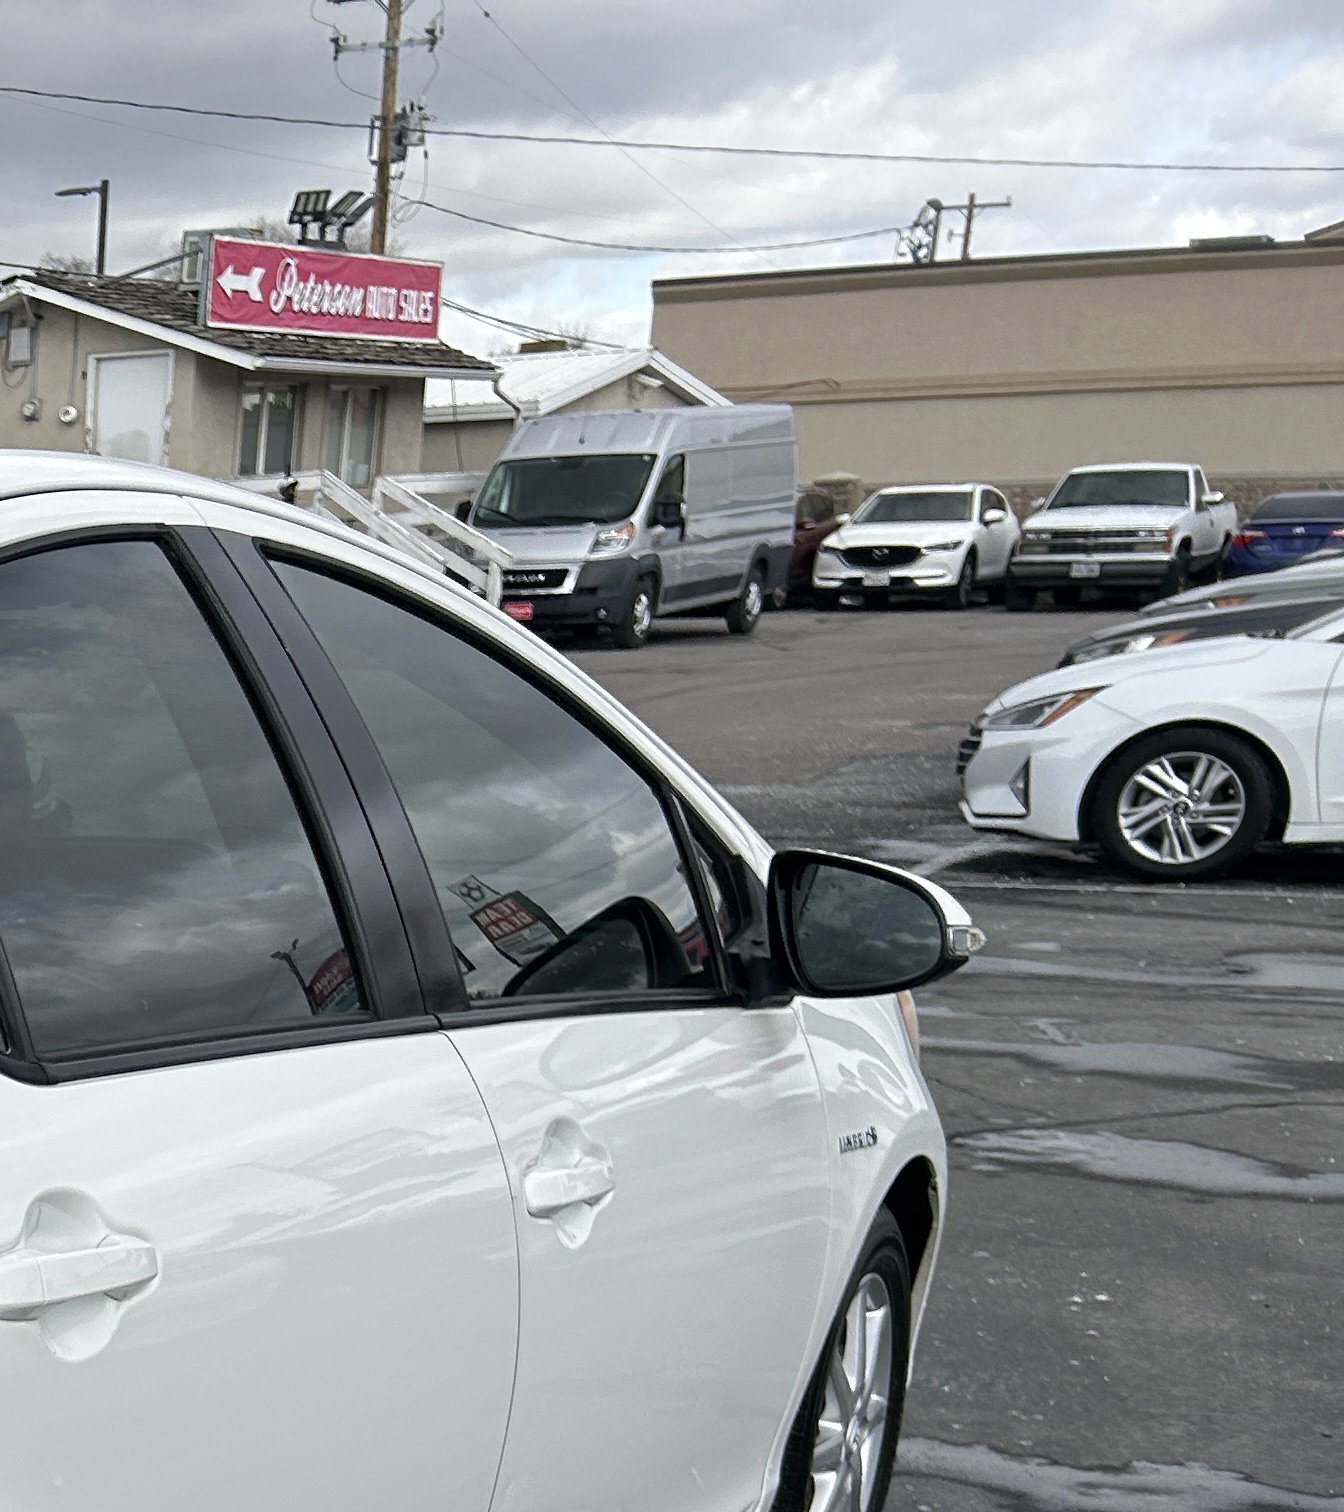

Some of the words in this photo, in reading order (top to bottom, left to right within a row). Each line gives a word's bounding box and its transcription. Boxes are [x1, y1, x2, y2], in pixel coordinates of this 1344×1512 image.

[269, 257, 365, 316] Peterson
[365, 285, 398, 320] AUTO
[398, 288, 434, 324] SALES
